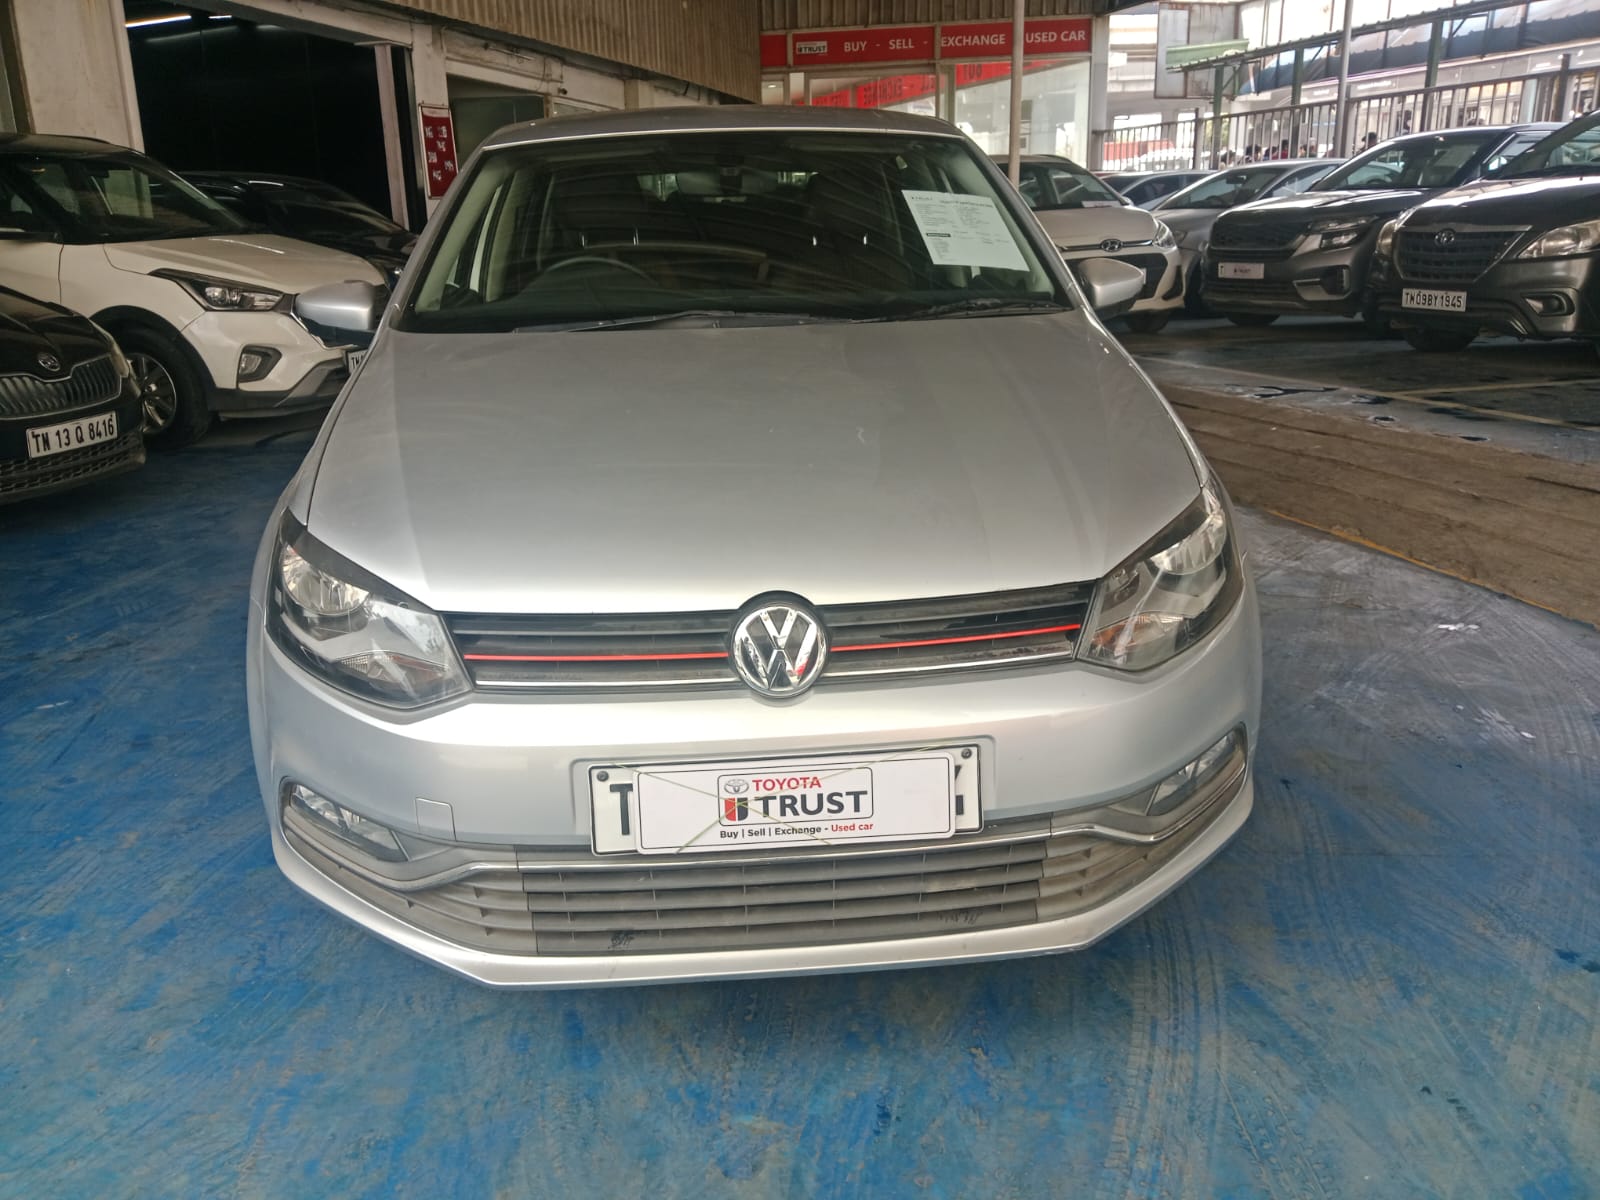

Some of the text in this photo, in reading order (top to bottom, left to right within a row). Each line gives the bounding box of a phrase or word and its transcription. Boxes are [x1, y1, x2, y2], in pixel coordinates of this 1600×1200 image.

[844, 41, 867, 52] BUY
[889, 38, 914, 50] SELL
[941, 33, 1006, 47] EXCHANGE
[1025, 31, 1057, 44] USED
[1061, 30, 1086, 42] CAR
[32, 418, 114, 453] TN 13 Q 8416
[752, 776, 822, 792] TOYOTA
[754, 790, 868, 818] TRUST
[720, 830, 739, 839] Buy
[747, 828, 766, 837] Sell
[774, 825, 822, 836] Exchange
[831, 824, 856, 833] Used
[858, 823, 874, 831] car
